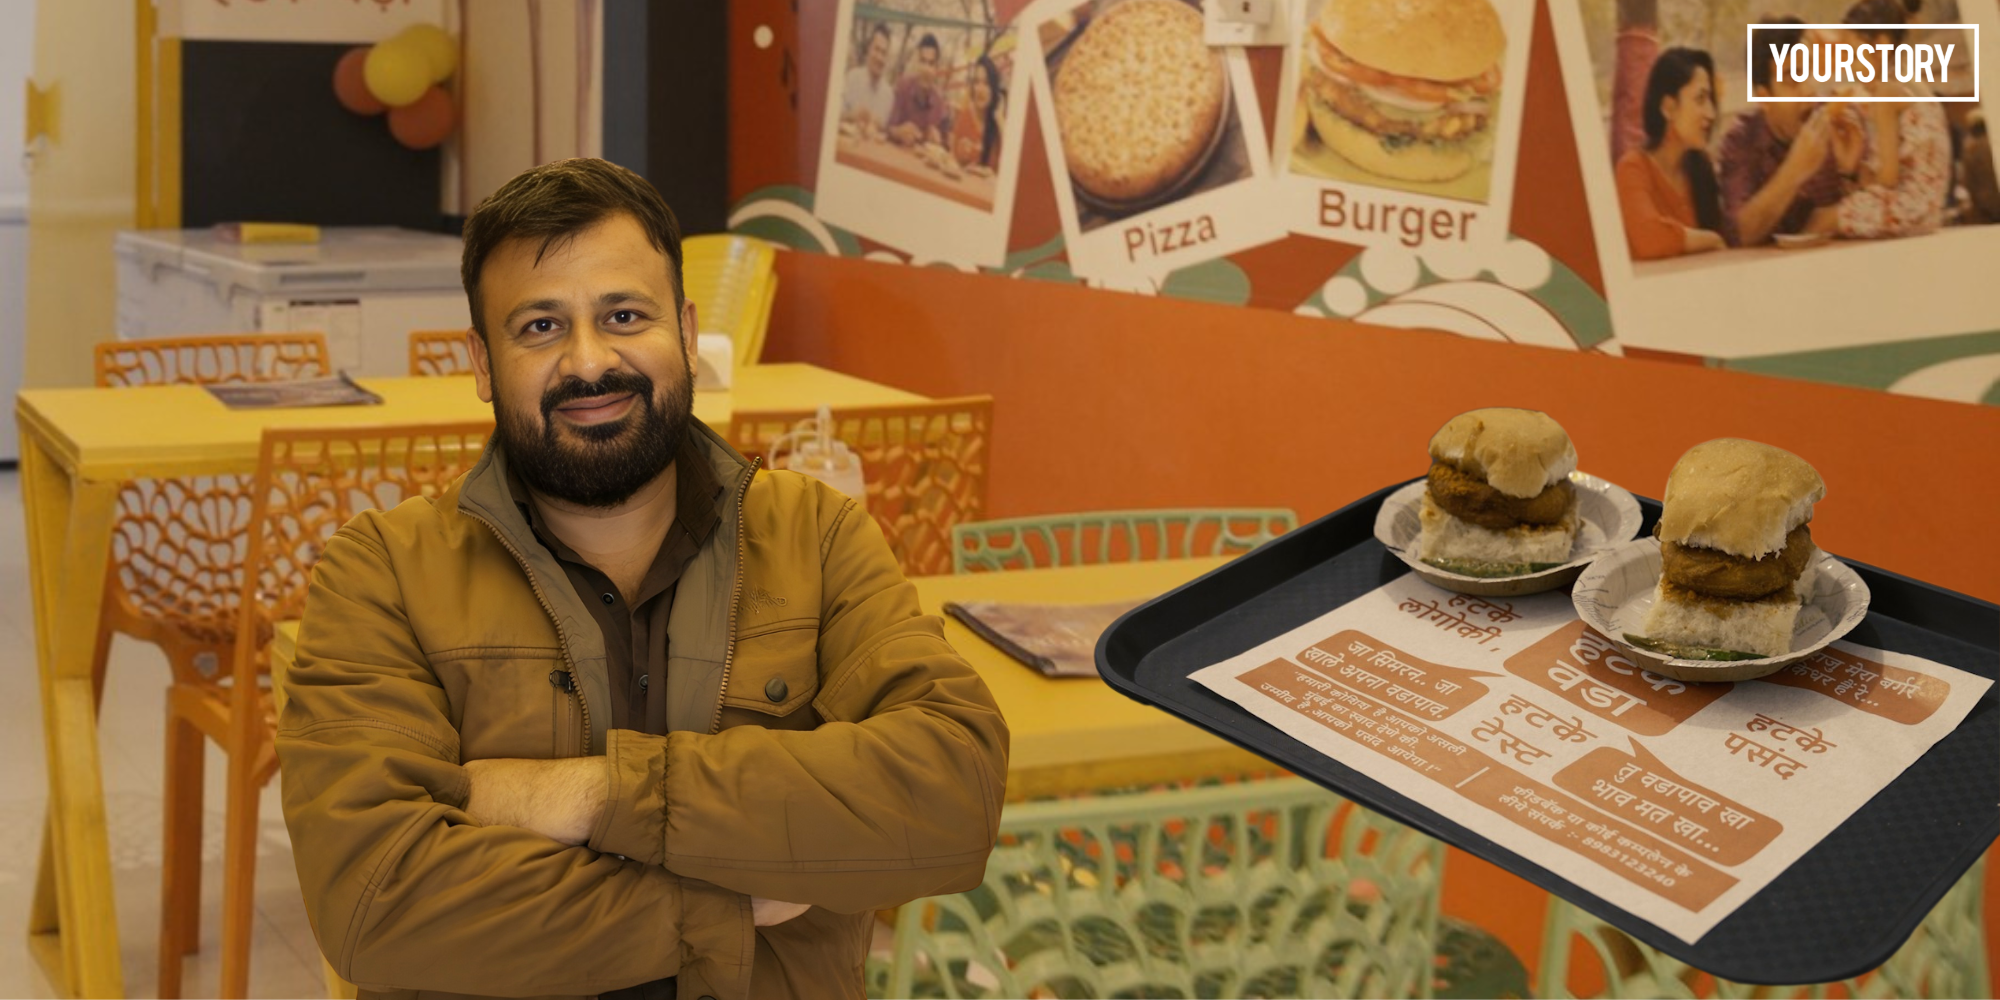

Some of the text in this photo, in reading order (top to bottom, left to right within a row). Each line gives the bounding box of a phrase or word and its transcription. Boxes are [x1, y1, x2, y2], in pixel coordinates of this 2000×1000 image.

[1124, 213, 1218, 262] Pizza
[1317, 187, 1478, 246] Burger
[1448, 594, 1523, 623] हटके
[1304, 646, 1344, 668] खाले
[1340, 664, 1389, 689] अपना
[1348, 640, 1374, 657] जा
[1435, 679, 1462, 695] जा
[1547, 659, 1648, 717] वडा
[1845, 662, 1880, 683] मेरा
[1880, 676, 1921, 699] बर्गर
[1260, 682, 1297, 703] उम्मीद
[1355, 729, 1385, 747] पसंद
[1330, 688, 1372, 711] कोशिश
[1373, 707, 1387, 717] है
[1385, 714, 1428, 736] आपको
[1426, 733, 1467, 756] असली
[1331, 702, 1350, 714] का
[1349, 711, 1379, 729] स्वाद
[1499, 693, 1599, 743] हटके
[1746, 712, 1838, 754] हटके
[1471, 716, 1553, 766] टेस्ट
[1724, 732, 1808, 780] पसंद
[1592, 779, 1638, 807] भाव
[1634, 799, 1675, 824] मत
[1614, 762, 1756, 830] तु वडापाव खा
[1528, 808, 1566, 831] संपर्क
[1582, 836, 1676, 888] 8983123240
[1567, 812, 1585, 826] या
[1585, 821, 1619, 841] कोई
[1674, 863, 1693, 881] के
